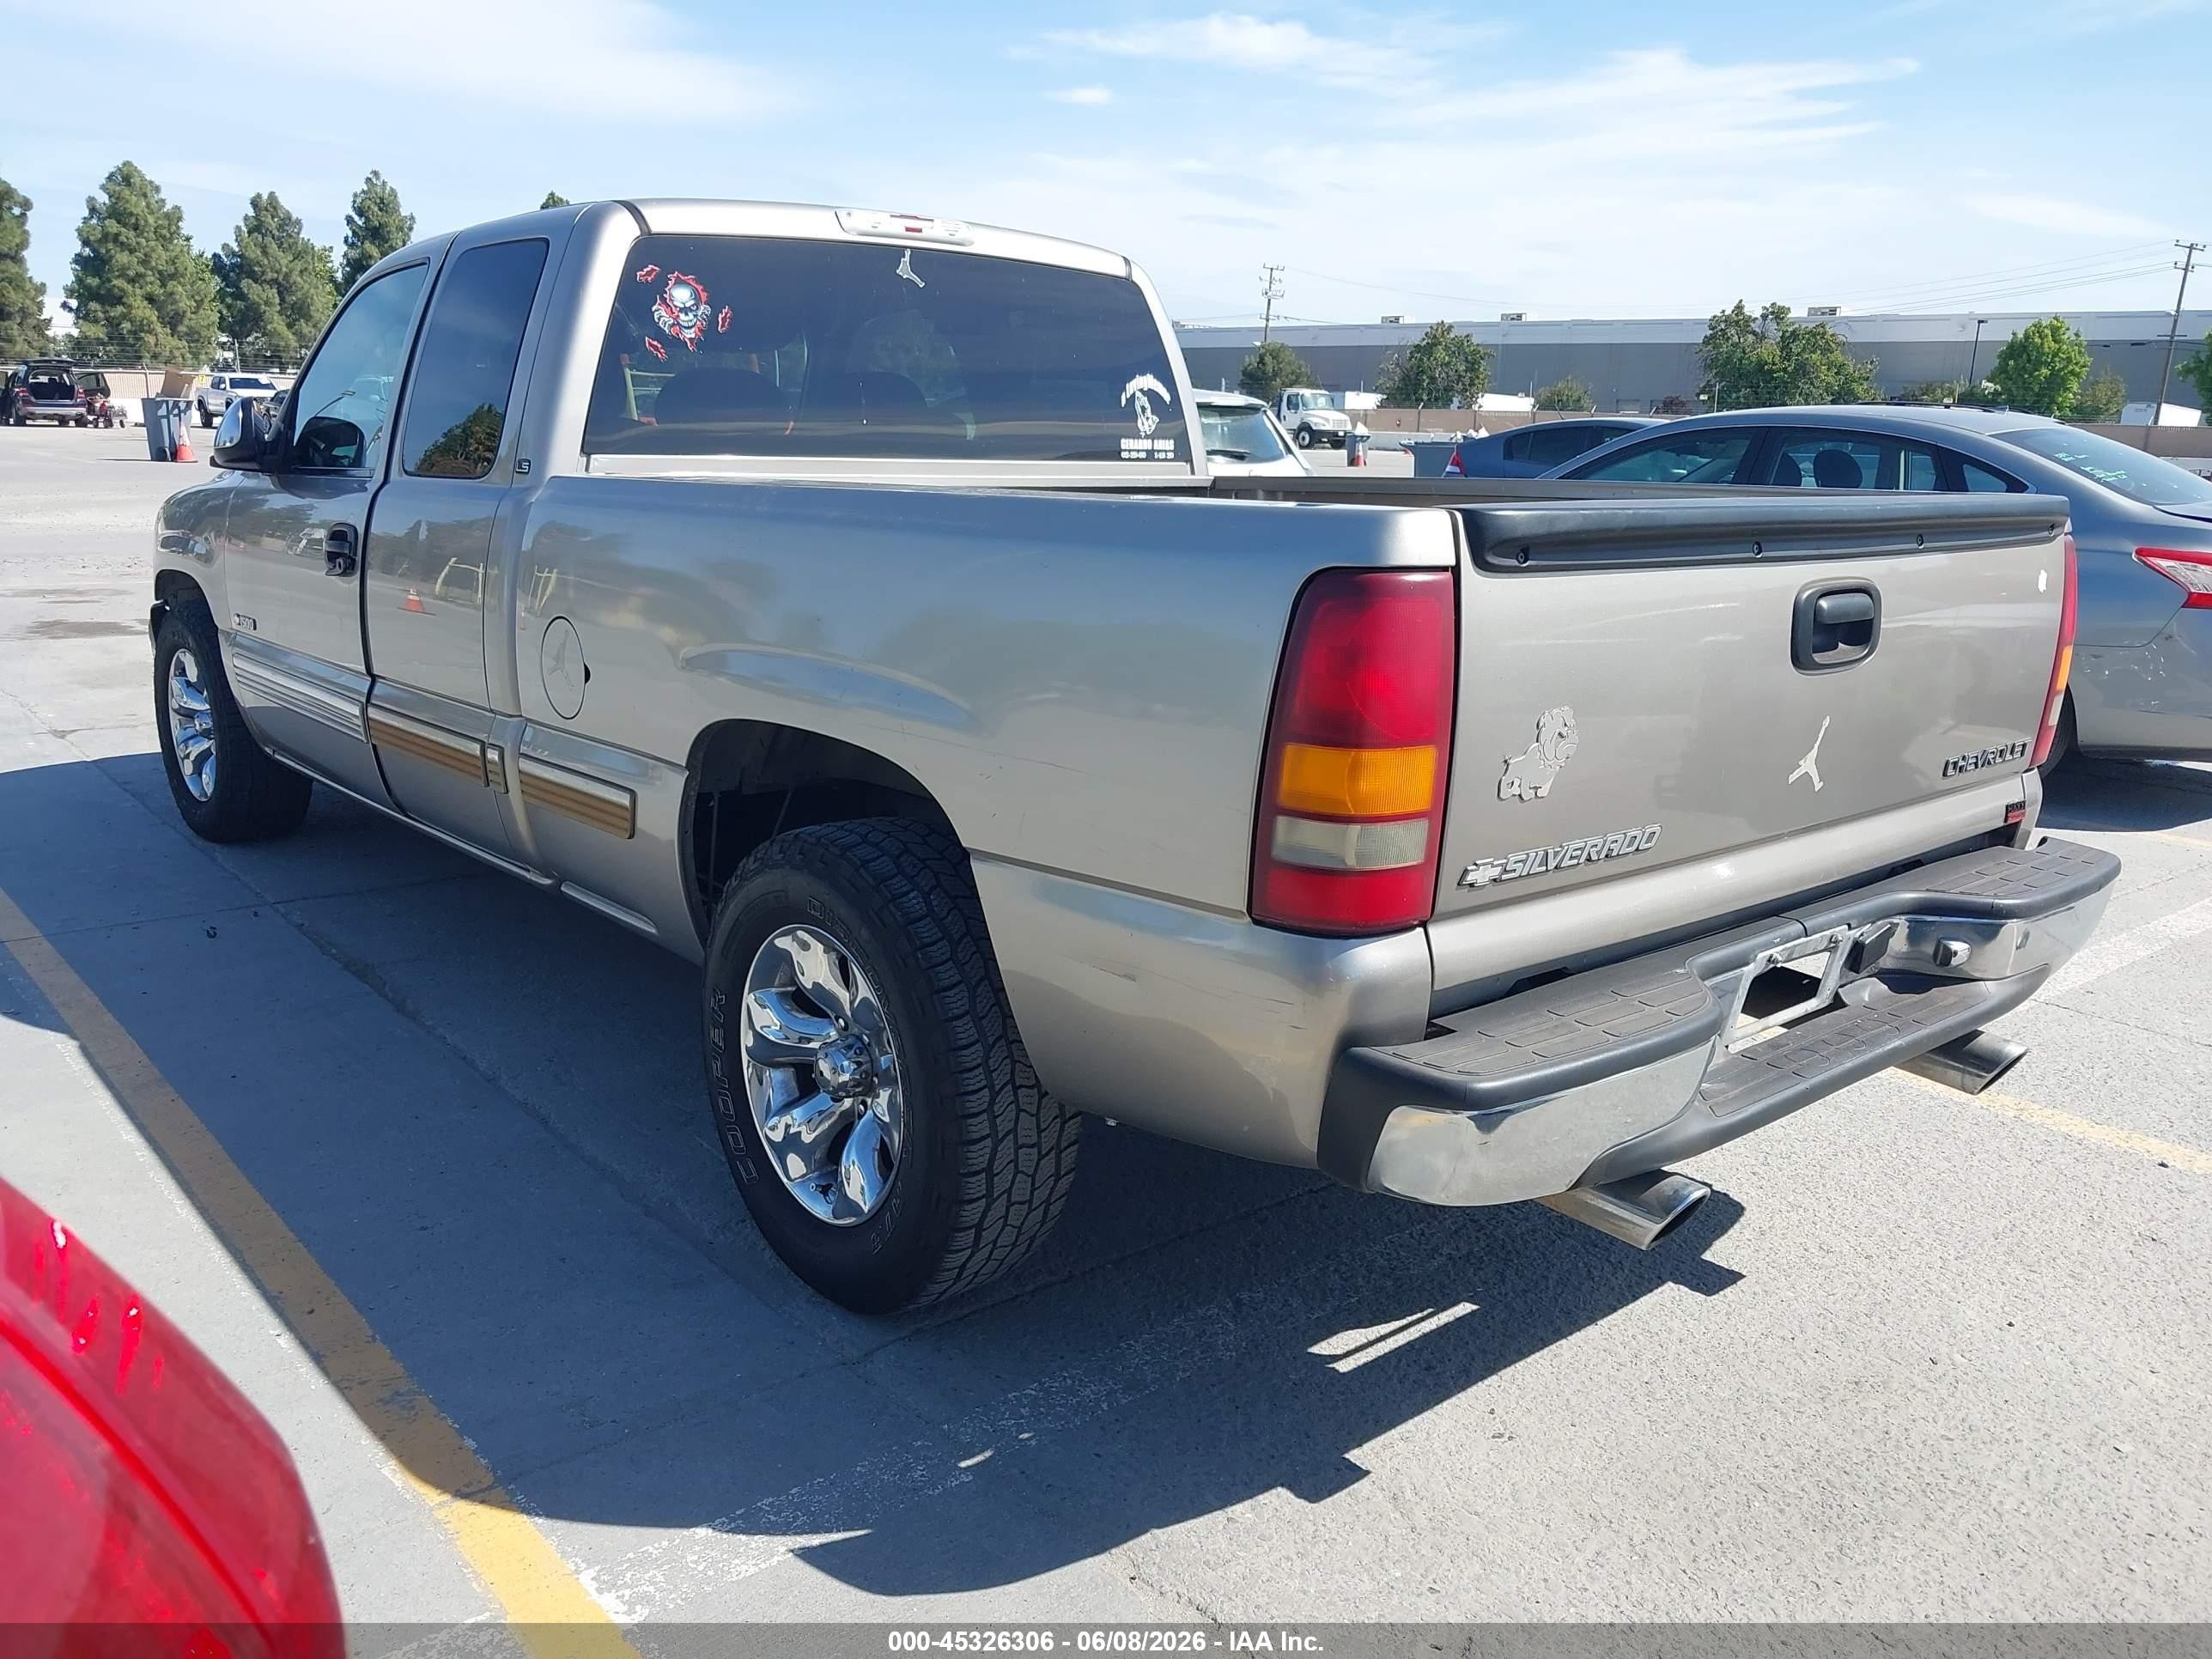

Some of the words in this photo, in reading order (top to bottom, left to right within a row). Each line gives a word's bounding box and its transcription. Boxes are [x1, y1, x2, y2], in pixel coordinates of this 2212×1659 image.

[515, 460, 530, 472] LS
[240, 615, 255, 629] 1500
[1942, 738, 2033, 777] CHEVROLET
[1501, 824, 1663, 881] SILVERADO
[710, 987, 759, 1183] COOPER
